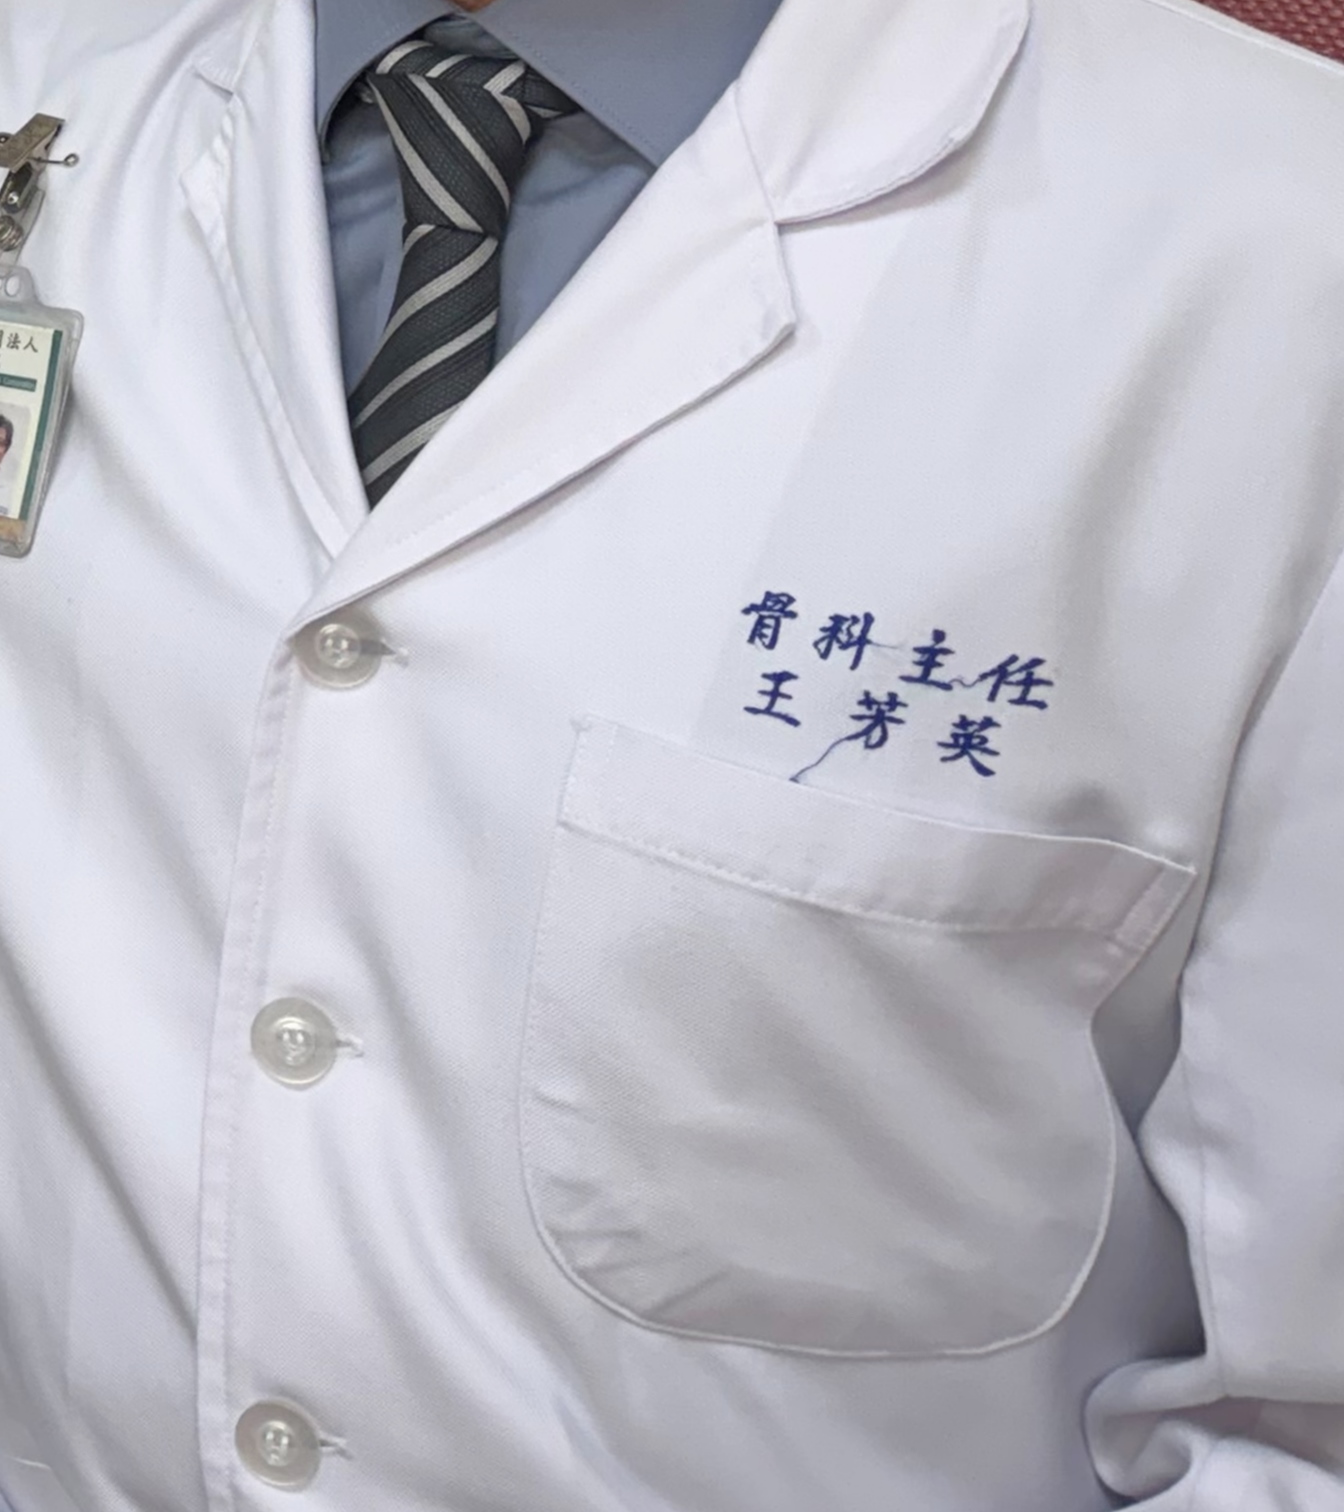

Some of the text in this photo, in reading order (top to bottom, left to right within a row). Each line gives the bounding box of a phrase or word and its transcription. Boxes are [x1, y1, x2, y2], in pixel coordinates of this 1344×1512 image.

[741, 591, 1054, 710] 骨科主任
[743, 671, 1002, 778] 王芳英
